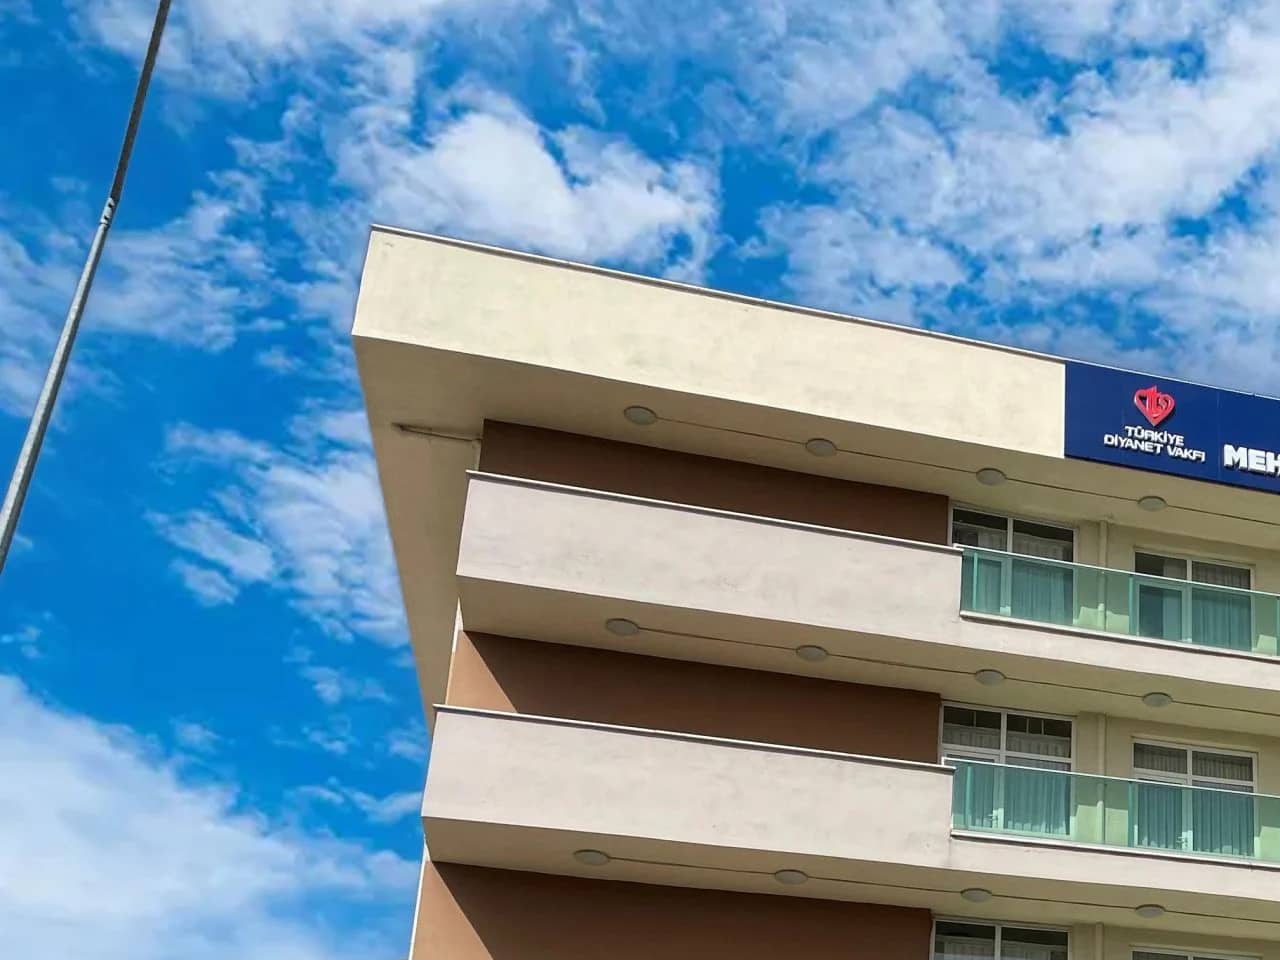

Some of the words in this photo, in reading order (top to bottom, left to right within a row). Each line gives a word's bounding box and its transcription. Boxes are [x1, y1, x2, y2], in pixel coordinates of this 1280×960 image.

[1103, 433, 1164, 455] DİYANET
[1166, 445, 1206, 462] VAKFI
[1124, 425, 1185, 447] TÜRKİYE
